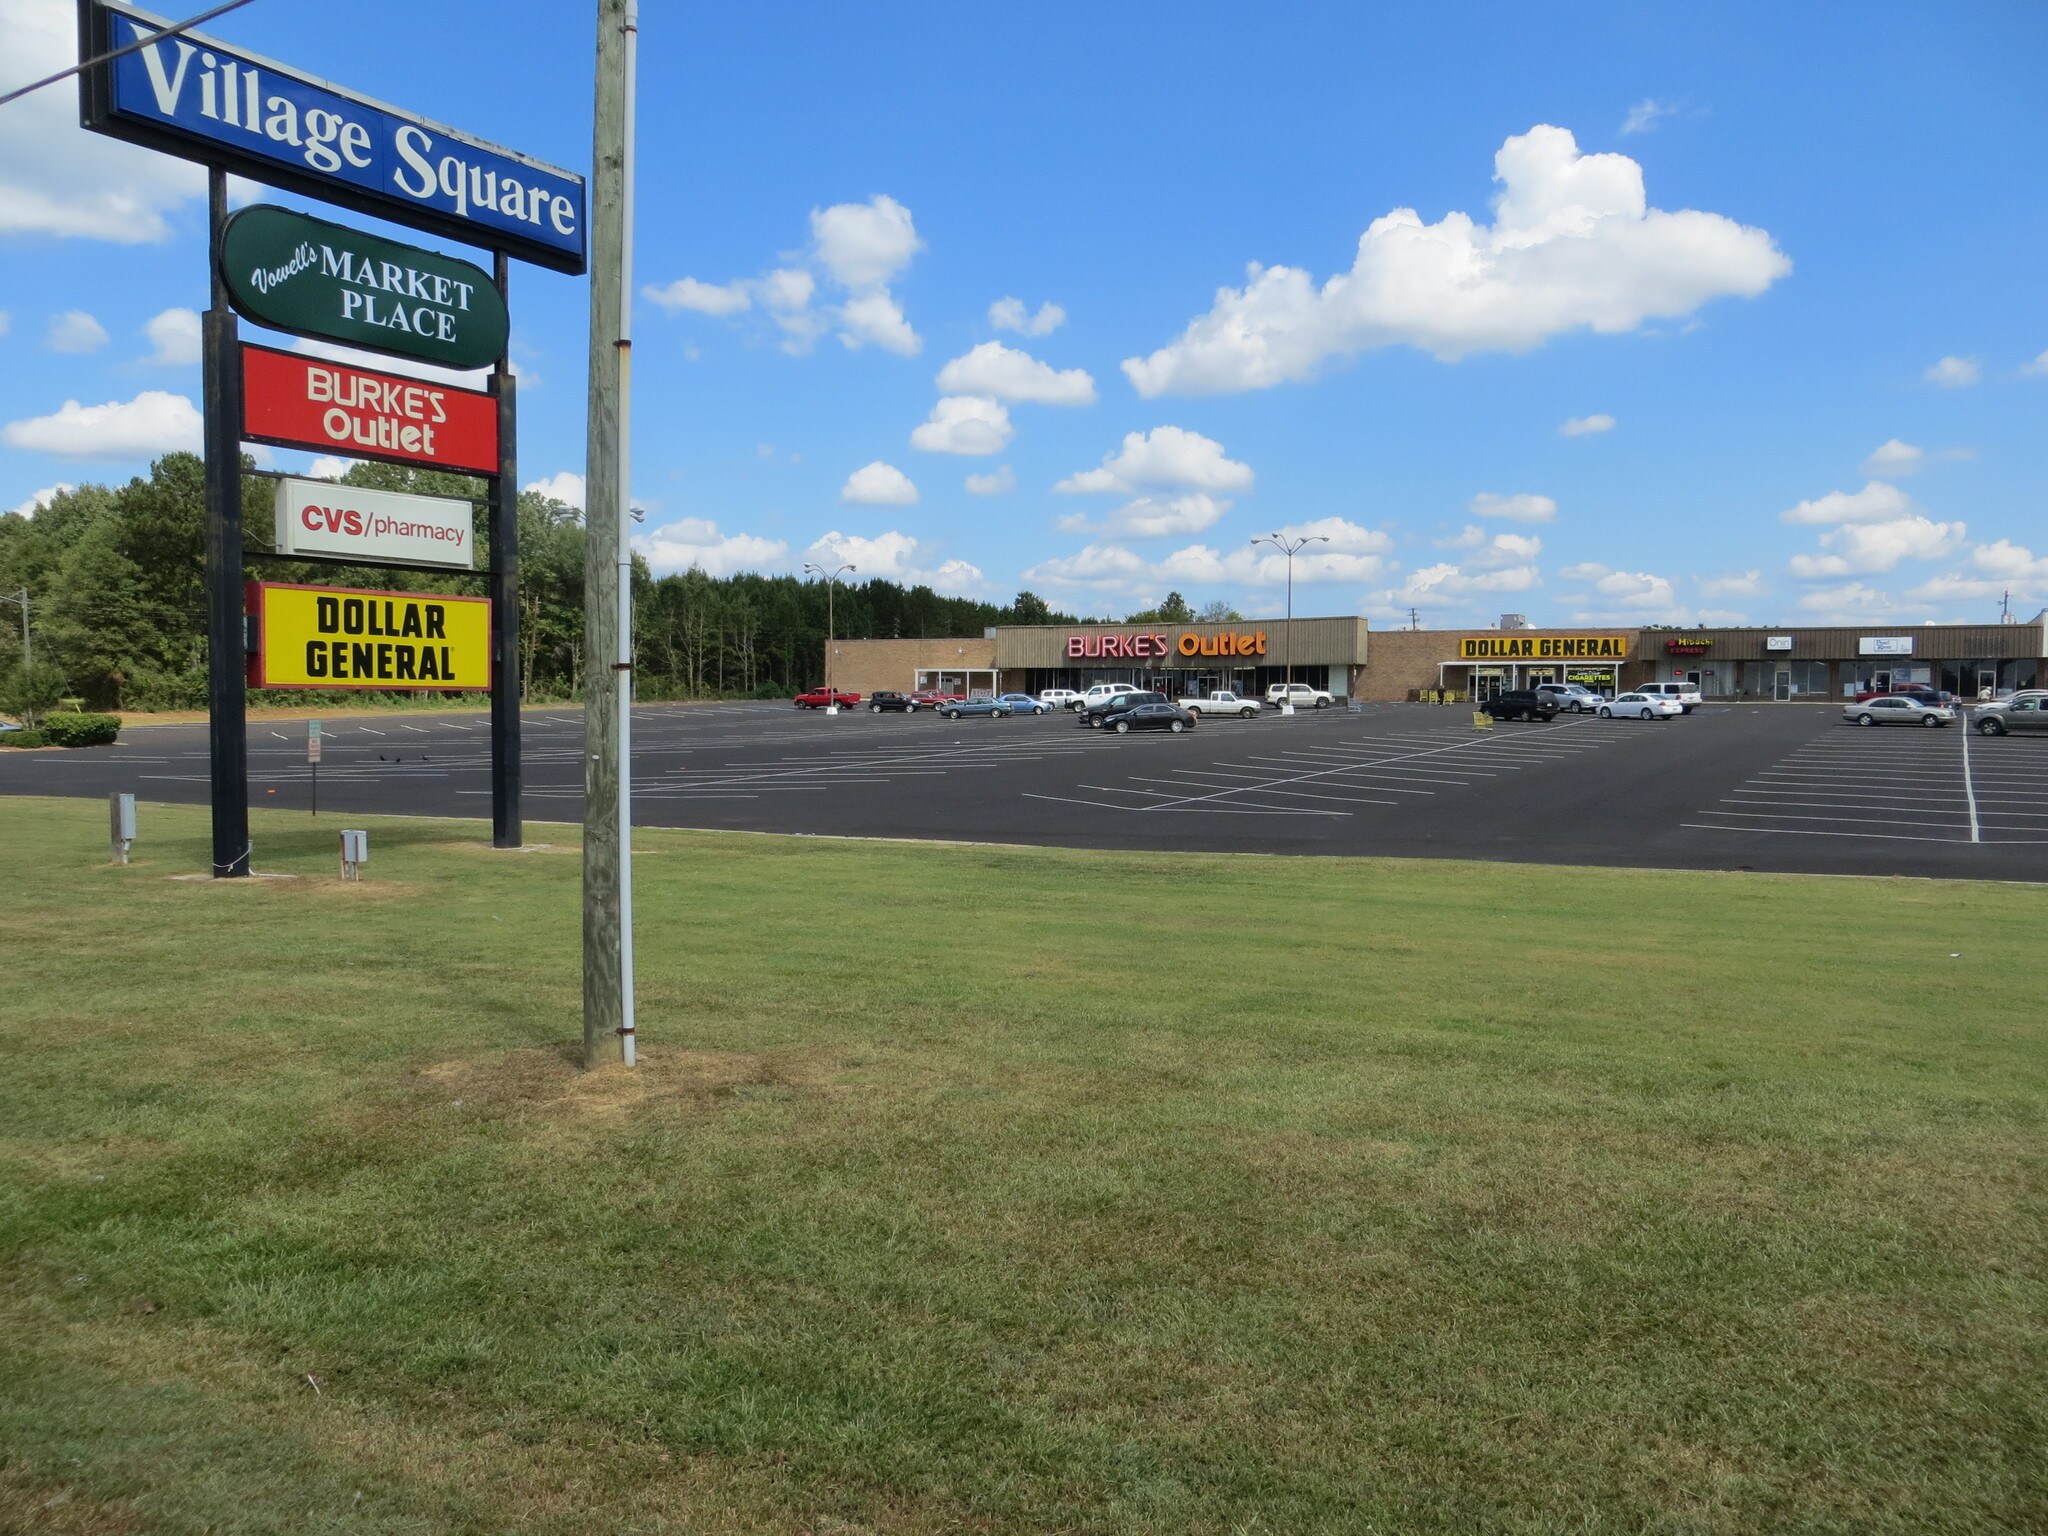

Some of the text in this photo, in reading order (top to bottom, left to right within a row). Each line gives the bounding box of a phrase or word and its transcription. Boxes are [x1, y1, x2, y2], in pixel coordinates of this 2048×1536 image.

[130, 22, 577, 236] Village Square
[251, 240, 474, 312] Vowell's MARKET
[341, 289, 458, 343] PLACE
[307, 366, 447, 424] BURKE'S
[323, 408, 435, 456] Outlet
[317, 596, 446, 639] DOLLAR
[306, 640, 455, 681] GENERAL
[1068, 631, 1266, 658] BURKE'S Outlet
[1465, 639, 1623, 657] DOLLAR GENERAL
